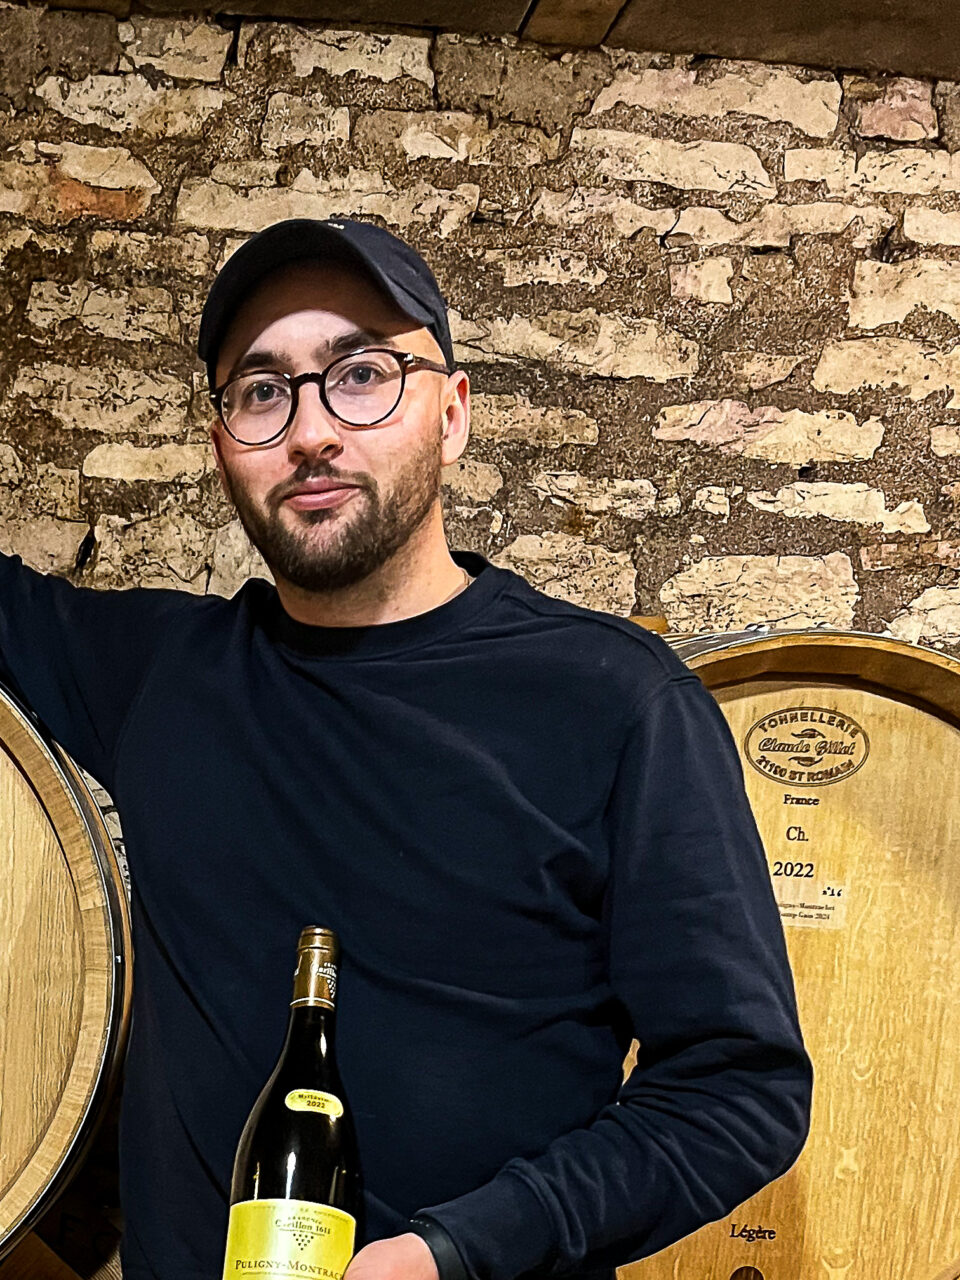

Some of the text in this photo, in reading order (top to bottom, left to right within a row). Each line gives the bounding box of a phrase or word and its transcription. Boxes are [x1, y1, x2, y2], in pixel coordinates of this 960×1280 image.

[783, 793, 820, 806] France
[785, 825, 809, 842] Ch.
[773, 861, 815, 878] 2022
[729, 1223, 776, 1242] Légère
